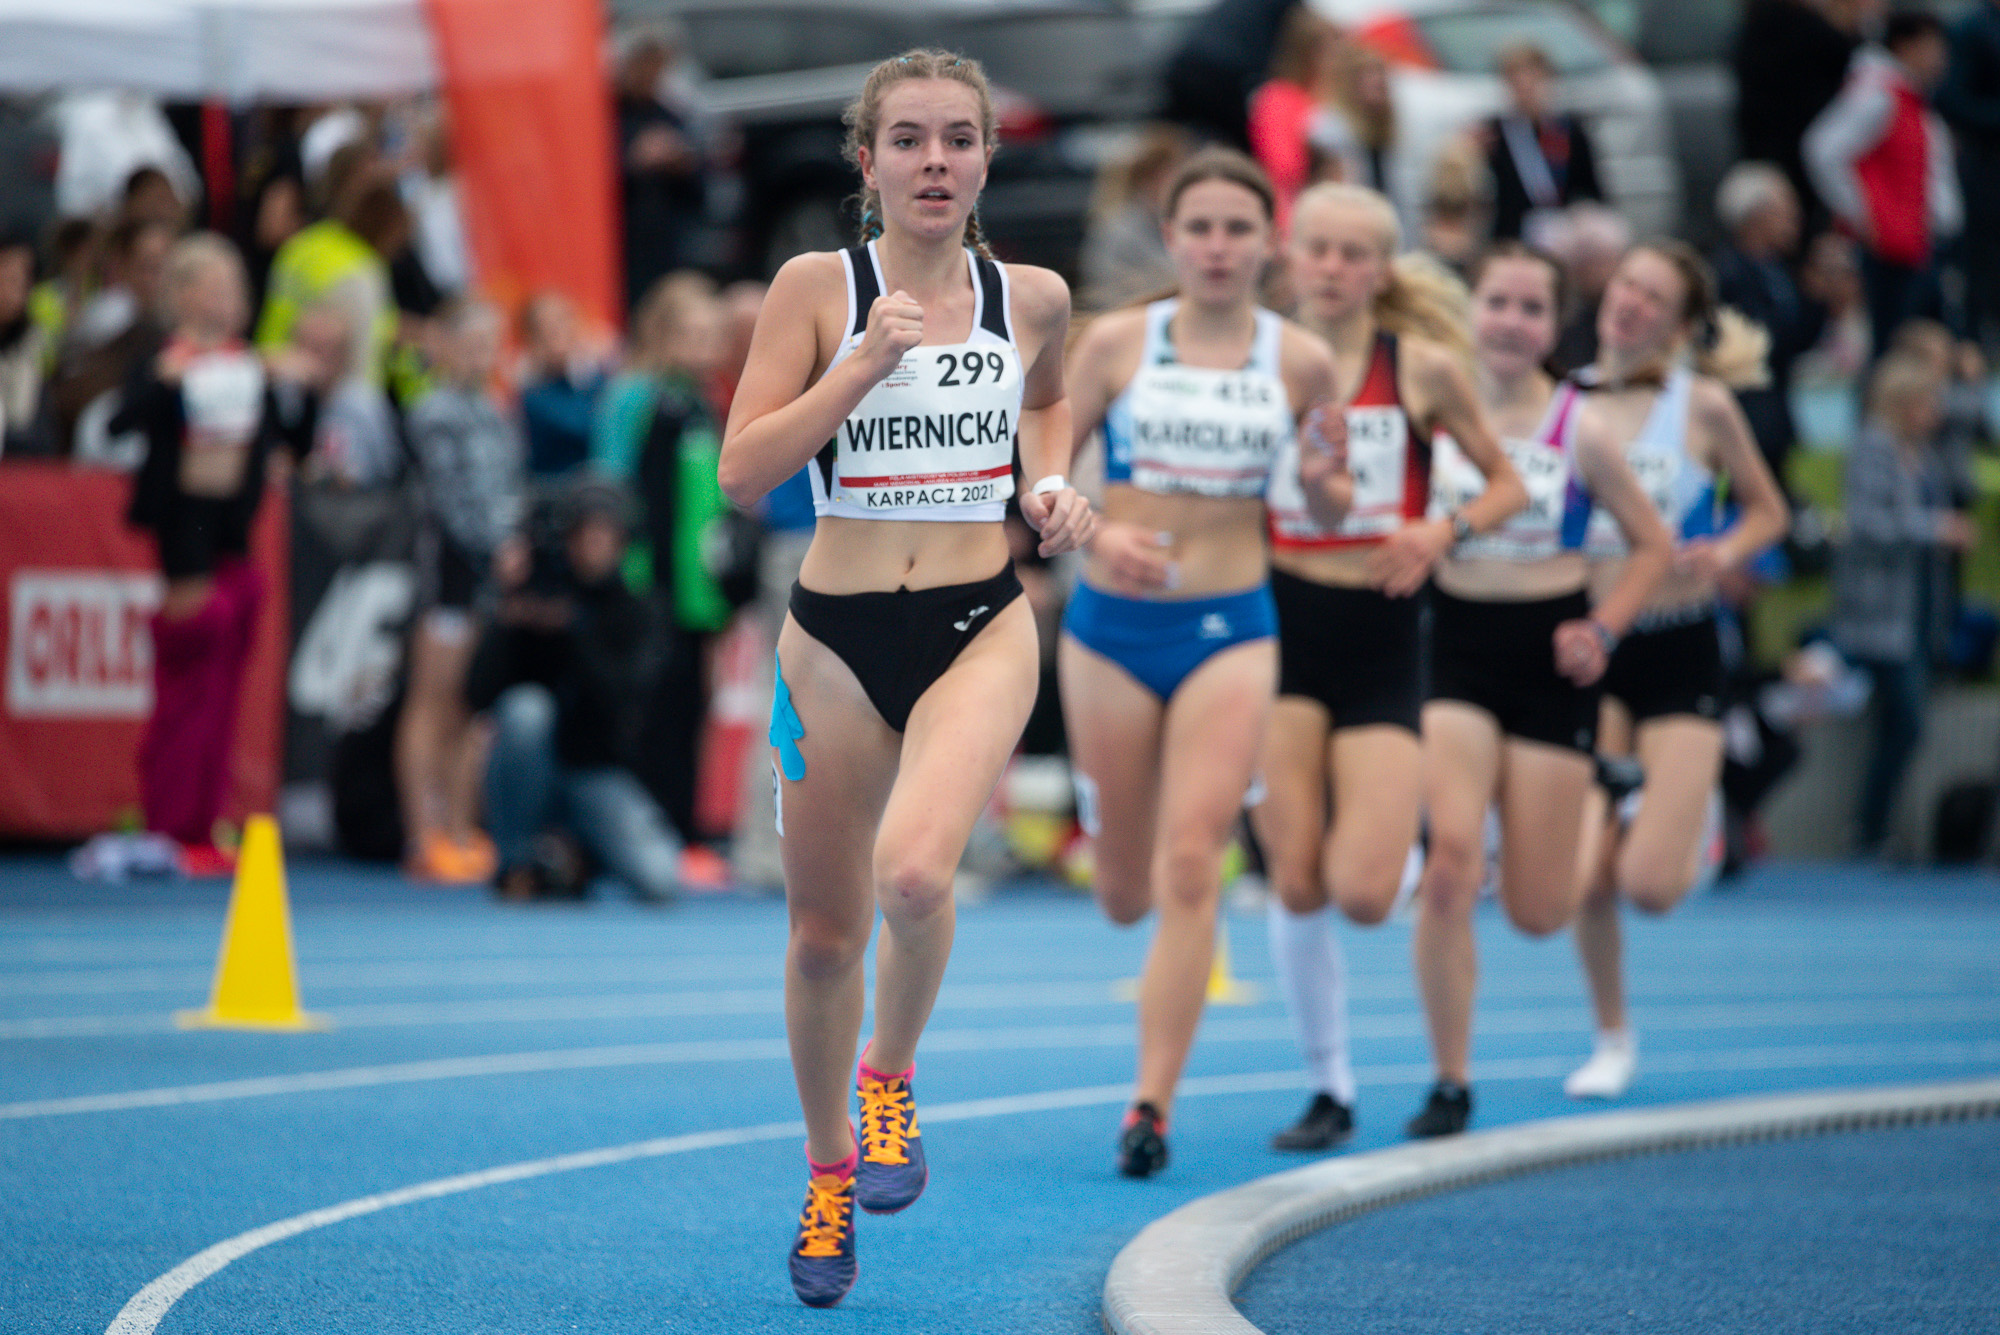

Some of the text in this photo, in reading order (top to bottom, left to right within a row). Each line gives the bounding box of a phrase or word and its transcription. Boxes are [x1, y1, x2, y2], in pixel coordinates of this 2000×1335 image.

[936, 351, 1004, 387] 299
[844, 409, 1009, 452] WIERNICKA
[867, 484, 994, 508] KARPACZ 2021
